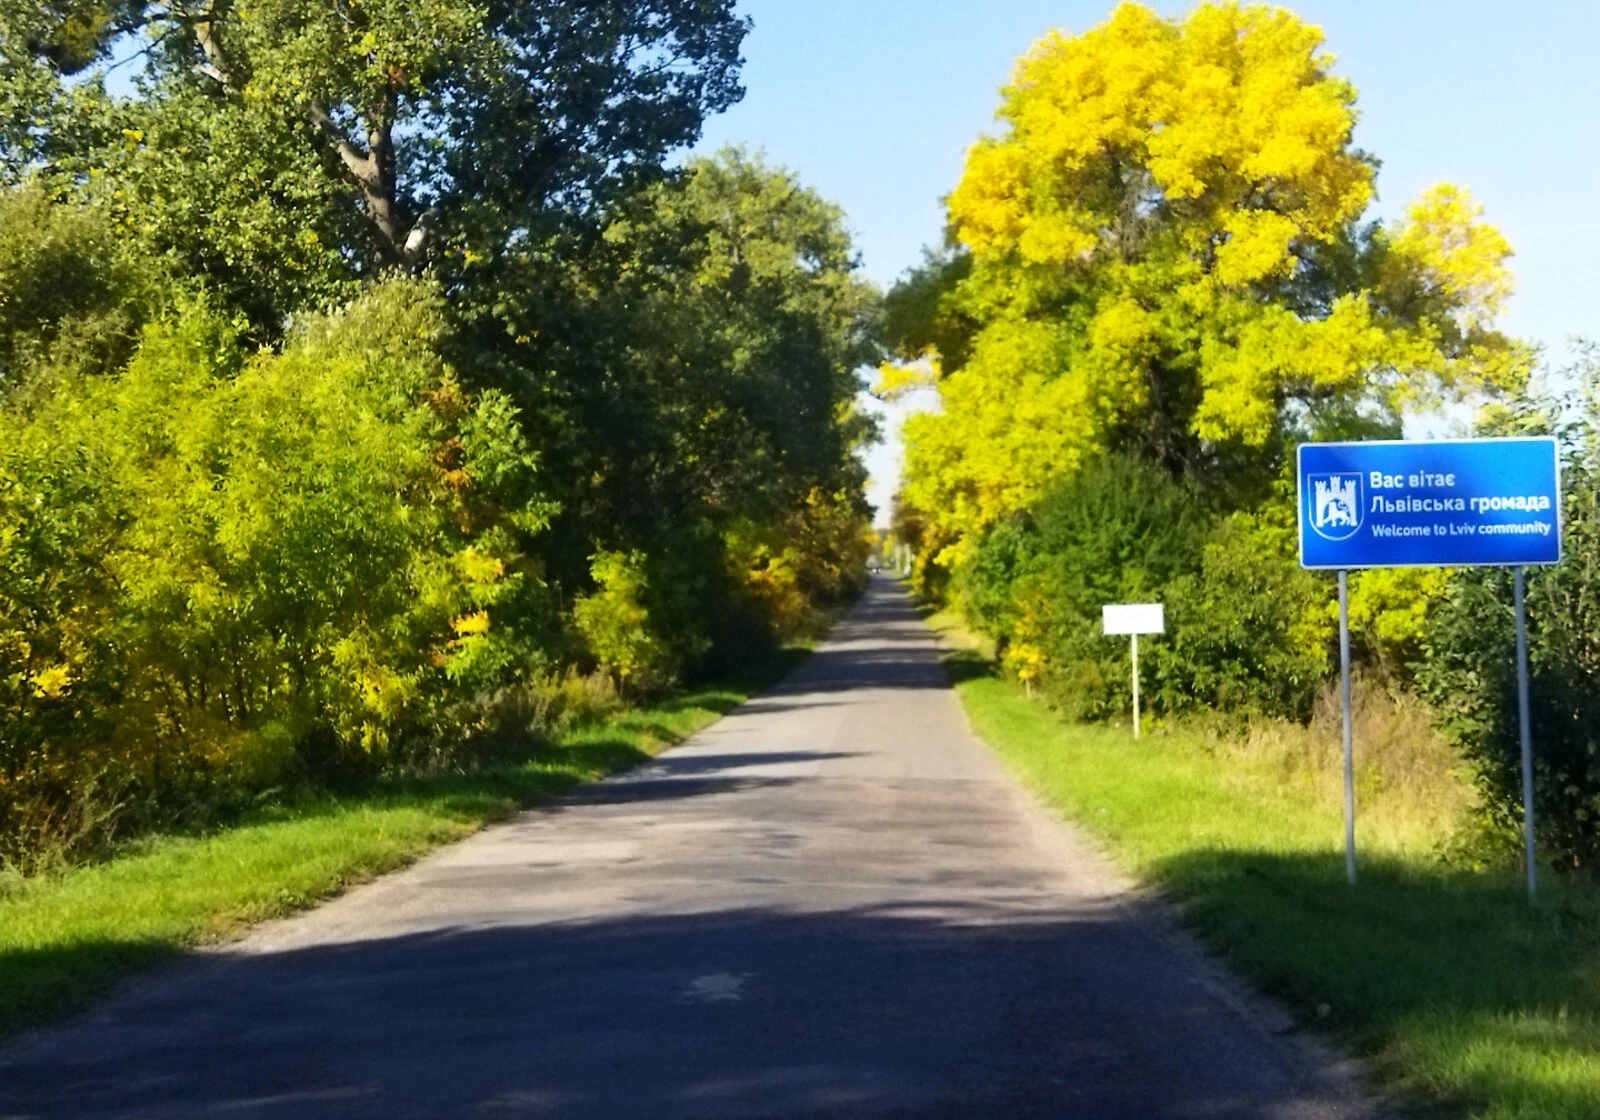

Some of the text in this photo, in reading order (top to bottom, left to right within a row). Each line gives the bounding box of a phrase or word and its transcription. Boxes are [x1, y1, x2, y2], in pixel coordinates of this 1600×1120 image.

[1370, 470, 1455, 489] Вас вітає
[1371, 494, 1550, 515] Львівська громада
[1372, 520, 1551, 537] Welcome to Lviv community
